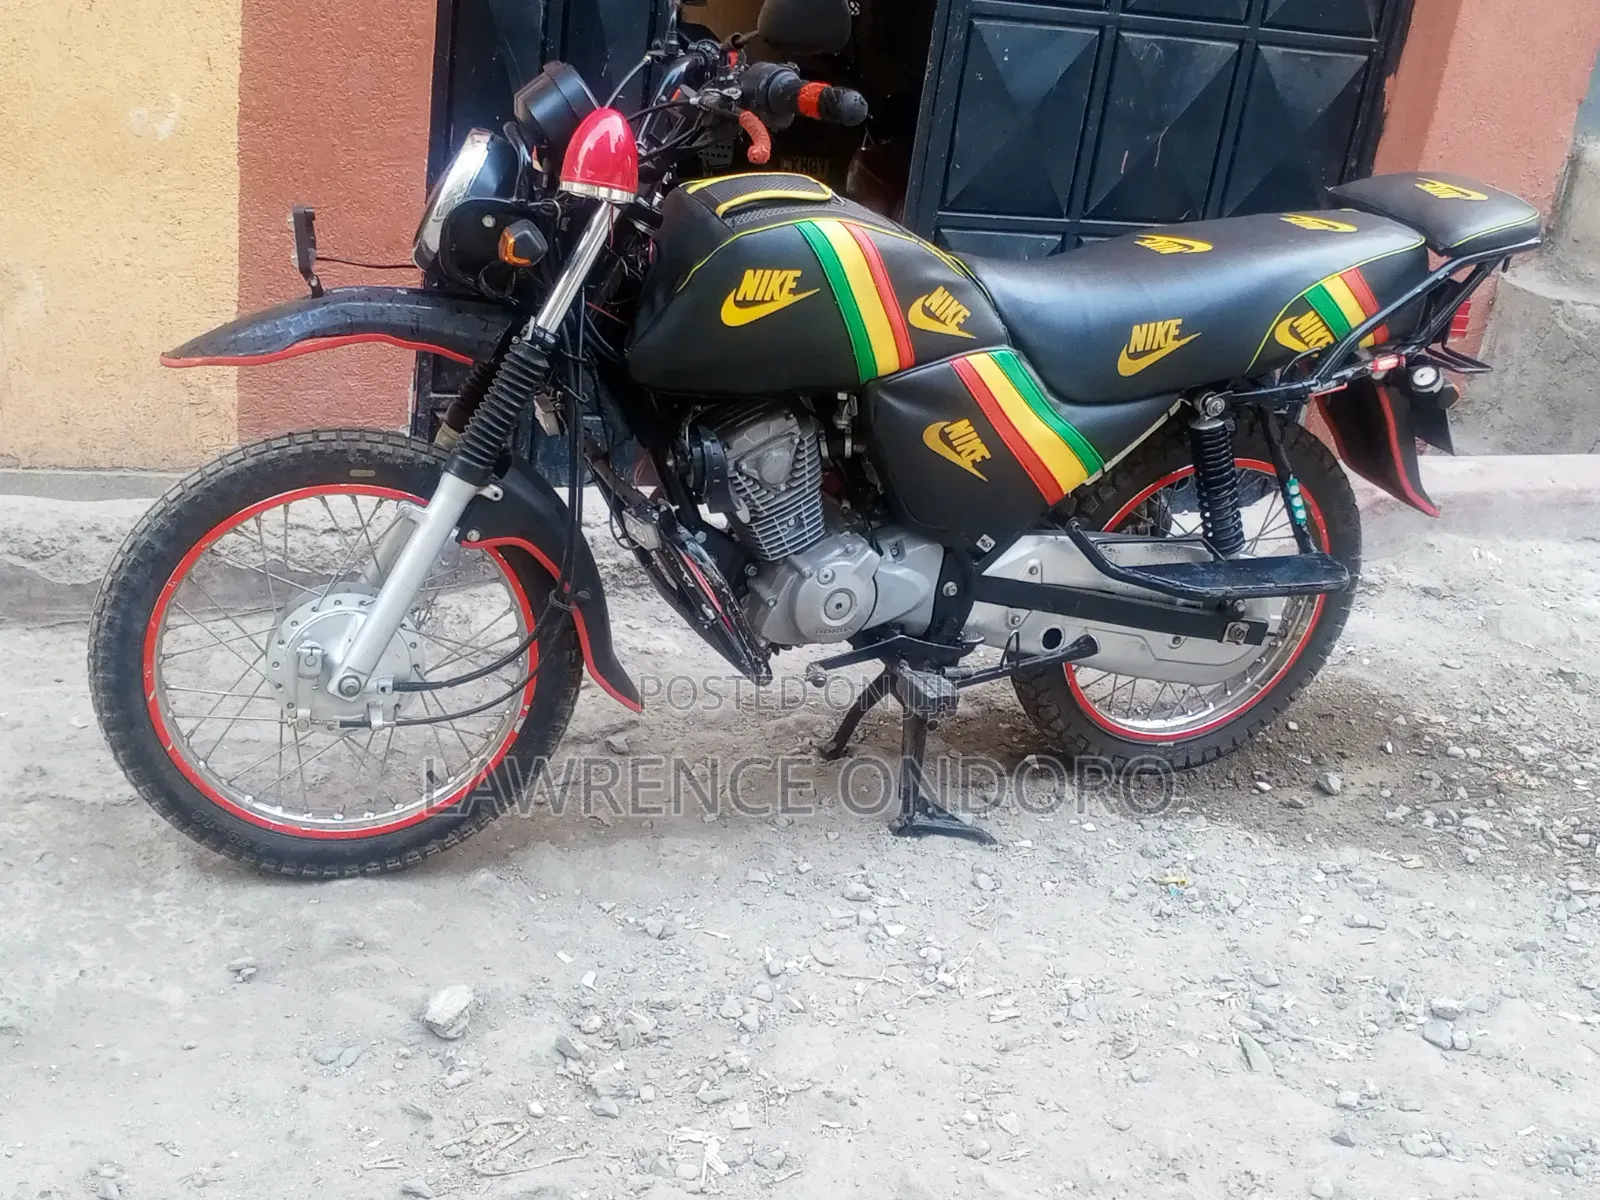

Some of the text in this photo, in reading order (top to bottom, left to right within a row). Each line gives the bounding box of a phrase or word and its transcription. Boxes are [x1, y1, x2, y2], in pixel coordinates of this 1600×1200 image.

[736, 269, 802, 301] NIKE
[923, 285, 972, 328] NIKE
[1129, 318, 1183, 354] NIKE
[1292, 310, 1335, 350] NIKE
[943, 418, 992, 466] NIKE
